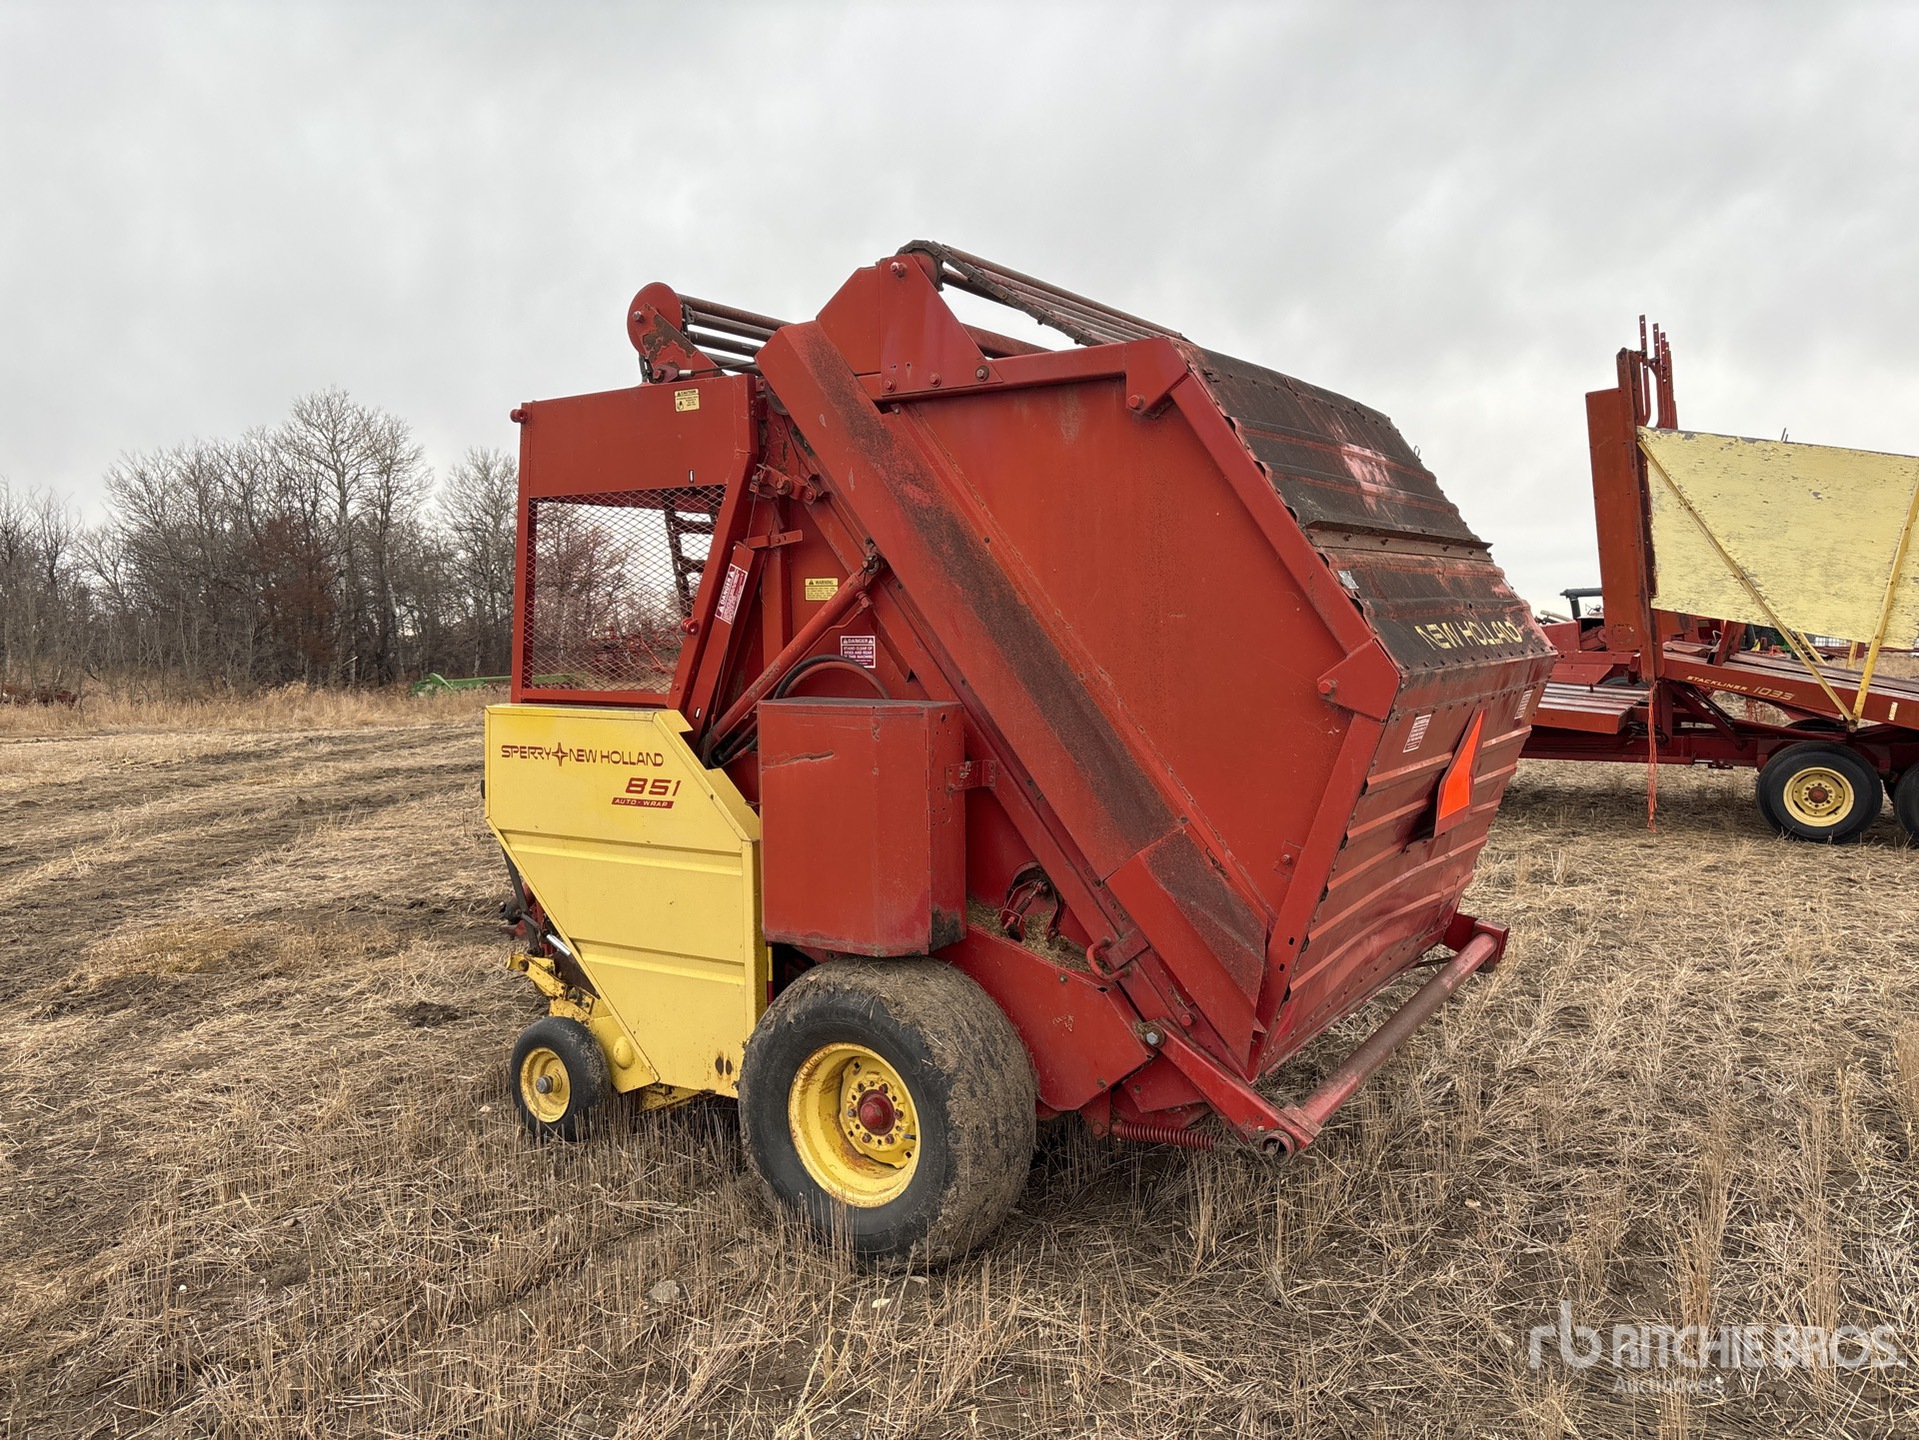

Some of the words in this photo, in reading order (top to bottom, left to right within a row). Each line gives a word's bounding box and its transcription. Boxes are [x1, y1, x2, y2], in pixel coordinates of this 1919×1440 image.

[720, 577, 732, 605] DANGER
[1414, 622, 1464, 650] NEW
[1454, 620, 1523, 646] HOLLAND
[1686, 675, 1748, 691] STACKLINER
[1753, 686, 1795, 701] 1033
[501, 744, 551, 761] SPERRY
[569, 748, 597, 763] NEW
[600, 750, 664, 767] HOLLAND
[625, 777, 681, 797] 851
